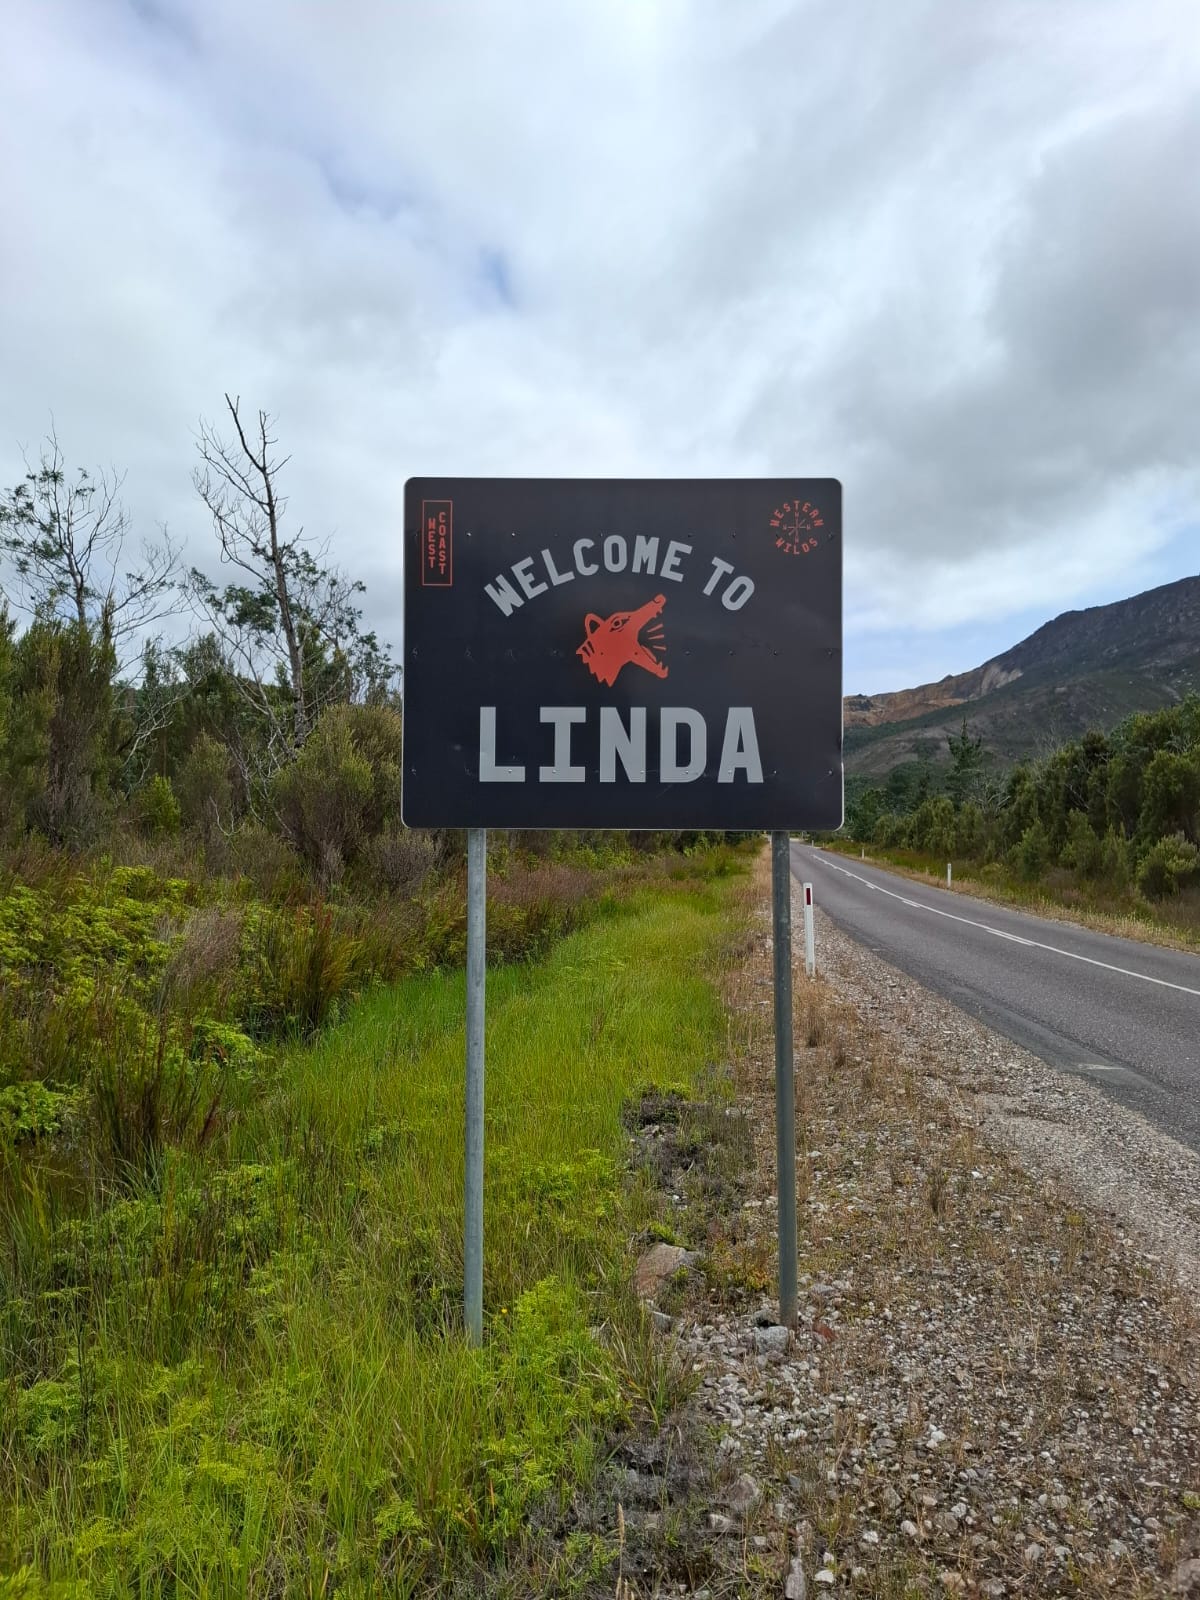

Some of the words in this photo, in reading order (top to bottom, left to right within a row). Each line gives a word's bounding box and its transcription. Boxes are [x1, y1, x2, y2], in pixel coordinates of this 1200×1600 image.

[428, 518, 436, 568] WEST
[438, 512, 446, 574] COAST
[769, 500, 824, 527] WESTERN
[484, 535, 693, 617] WELCOME
[702, 557, 755, 611] TO
[775, 537, 818, 555] WILDS
[479, 707, 764, 782] LINDA
